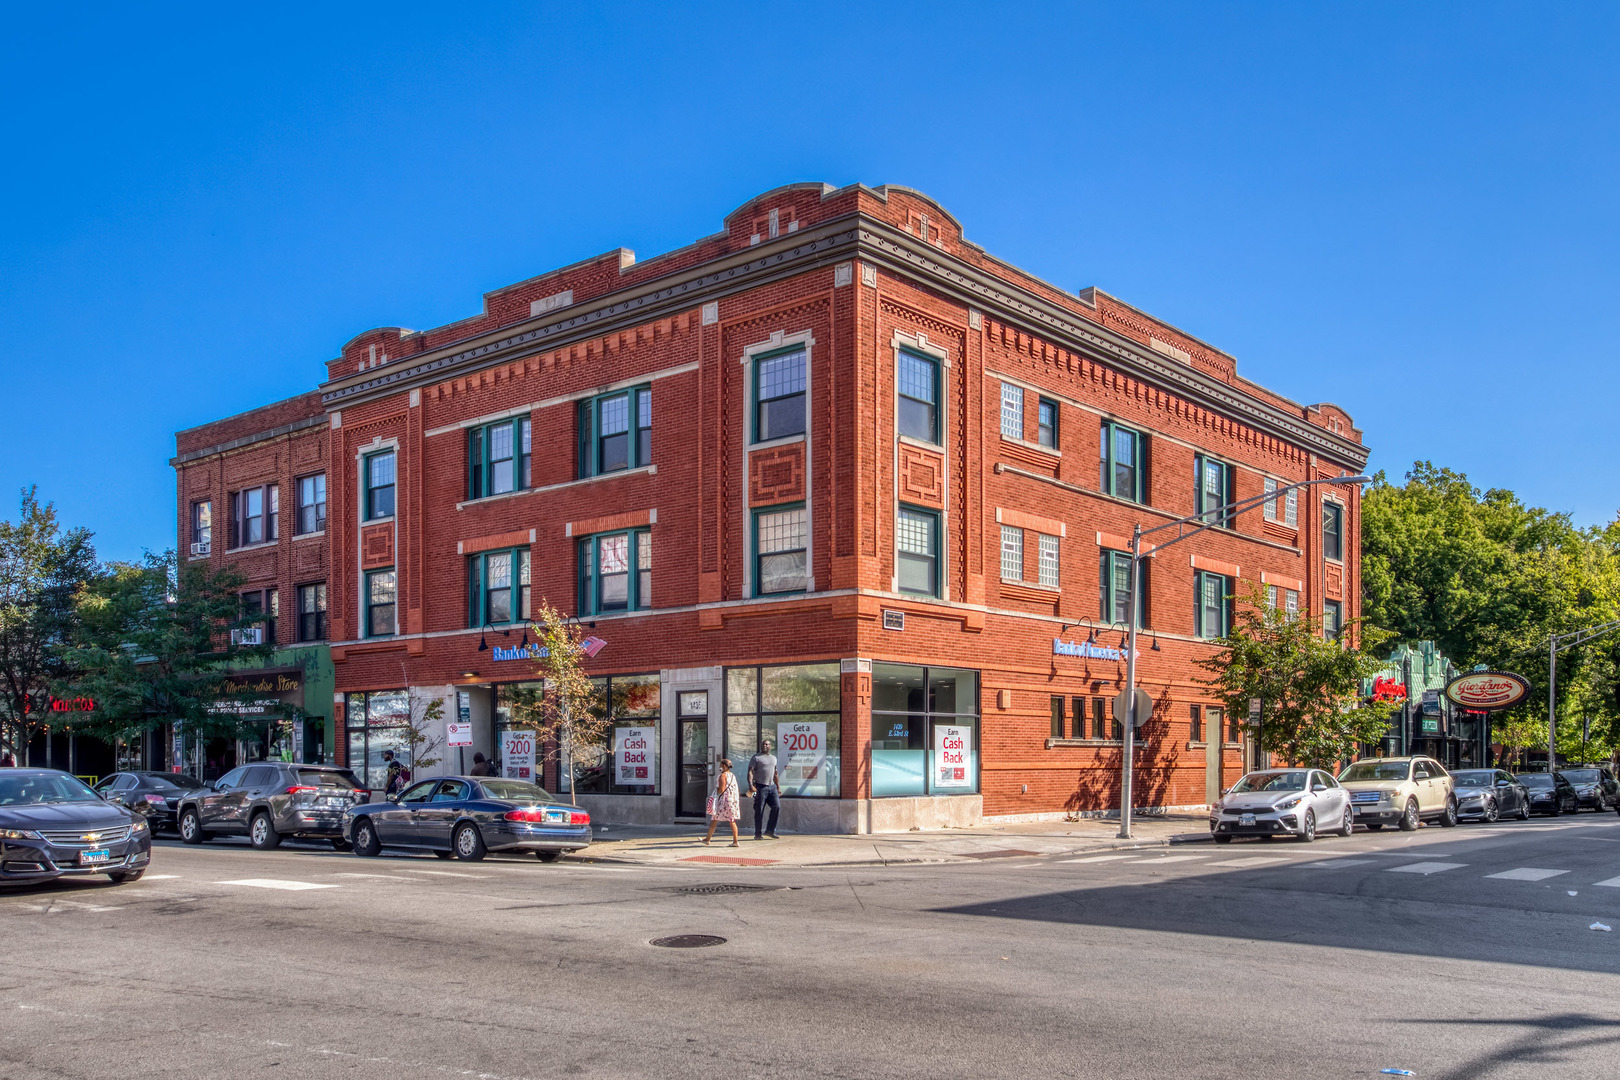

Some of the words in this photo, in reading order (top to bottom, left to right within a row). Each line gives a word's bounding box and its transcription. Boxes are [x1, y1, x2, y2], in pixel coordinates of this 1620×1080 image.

[493, 645, 519, 661] Bank
[1054, 638, 1075, 656] Bank
[1086, 642, 1120, 660] America
[226, 678, 273, 694] Merchndise
[276, 674, 299, 692] Store
[1455, 679, 1514, 696] Giordano's
[794, 724, 805, 732] Get
[506, 740, 530, 755] $200
[624, 738, 647, 749] Cash
[783, 733, 818, 751] $200
[942, 737, 963, 750] Cash
[624, 751, 646, 763] Back
[943, 751, 963, 763] Back
